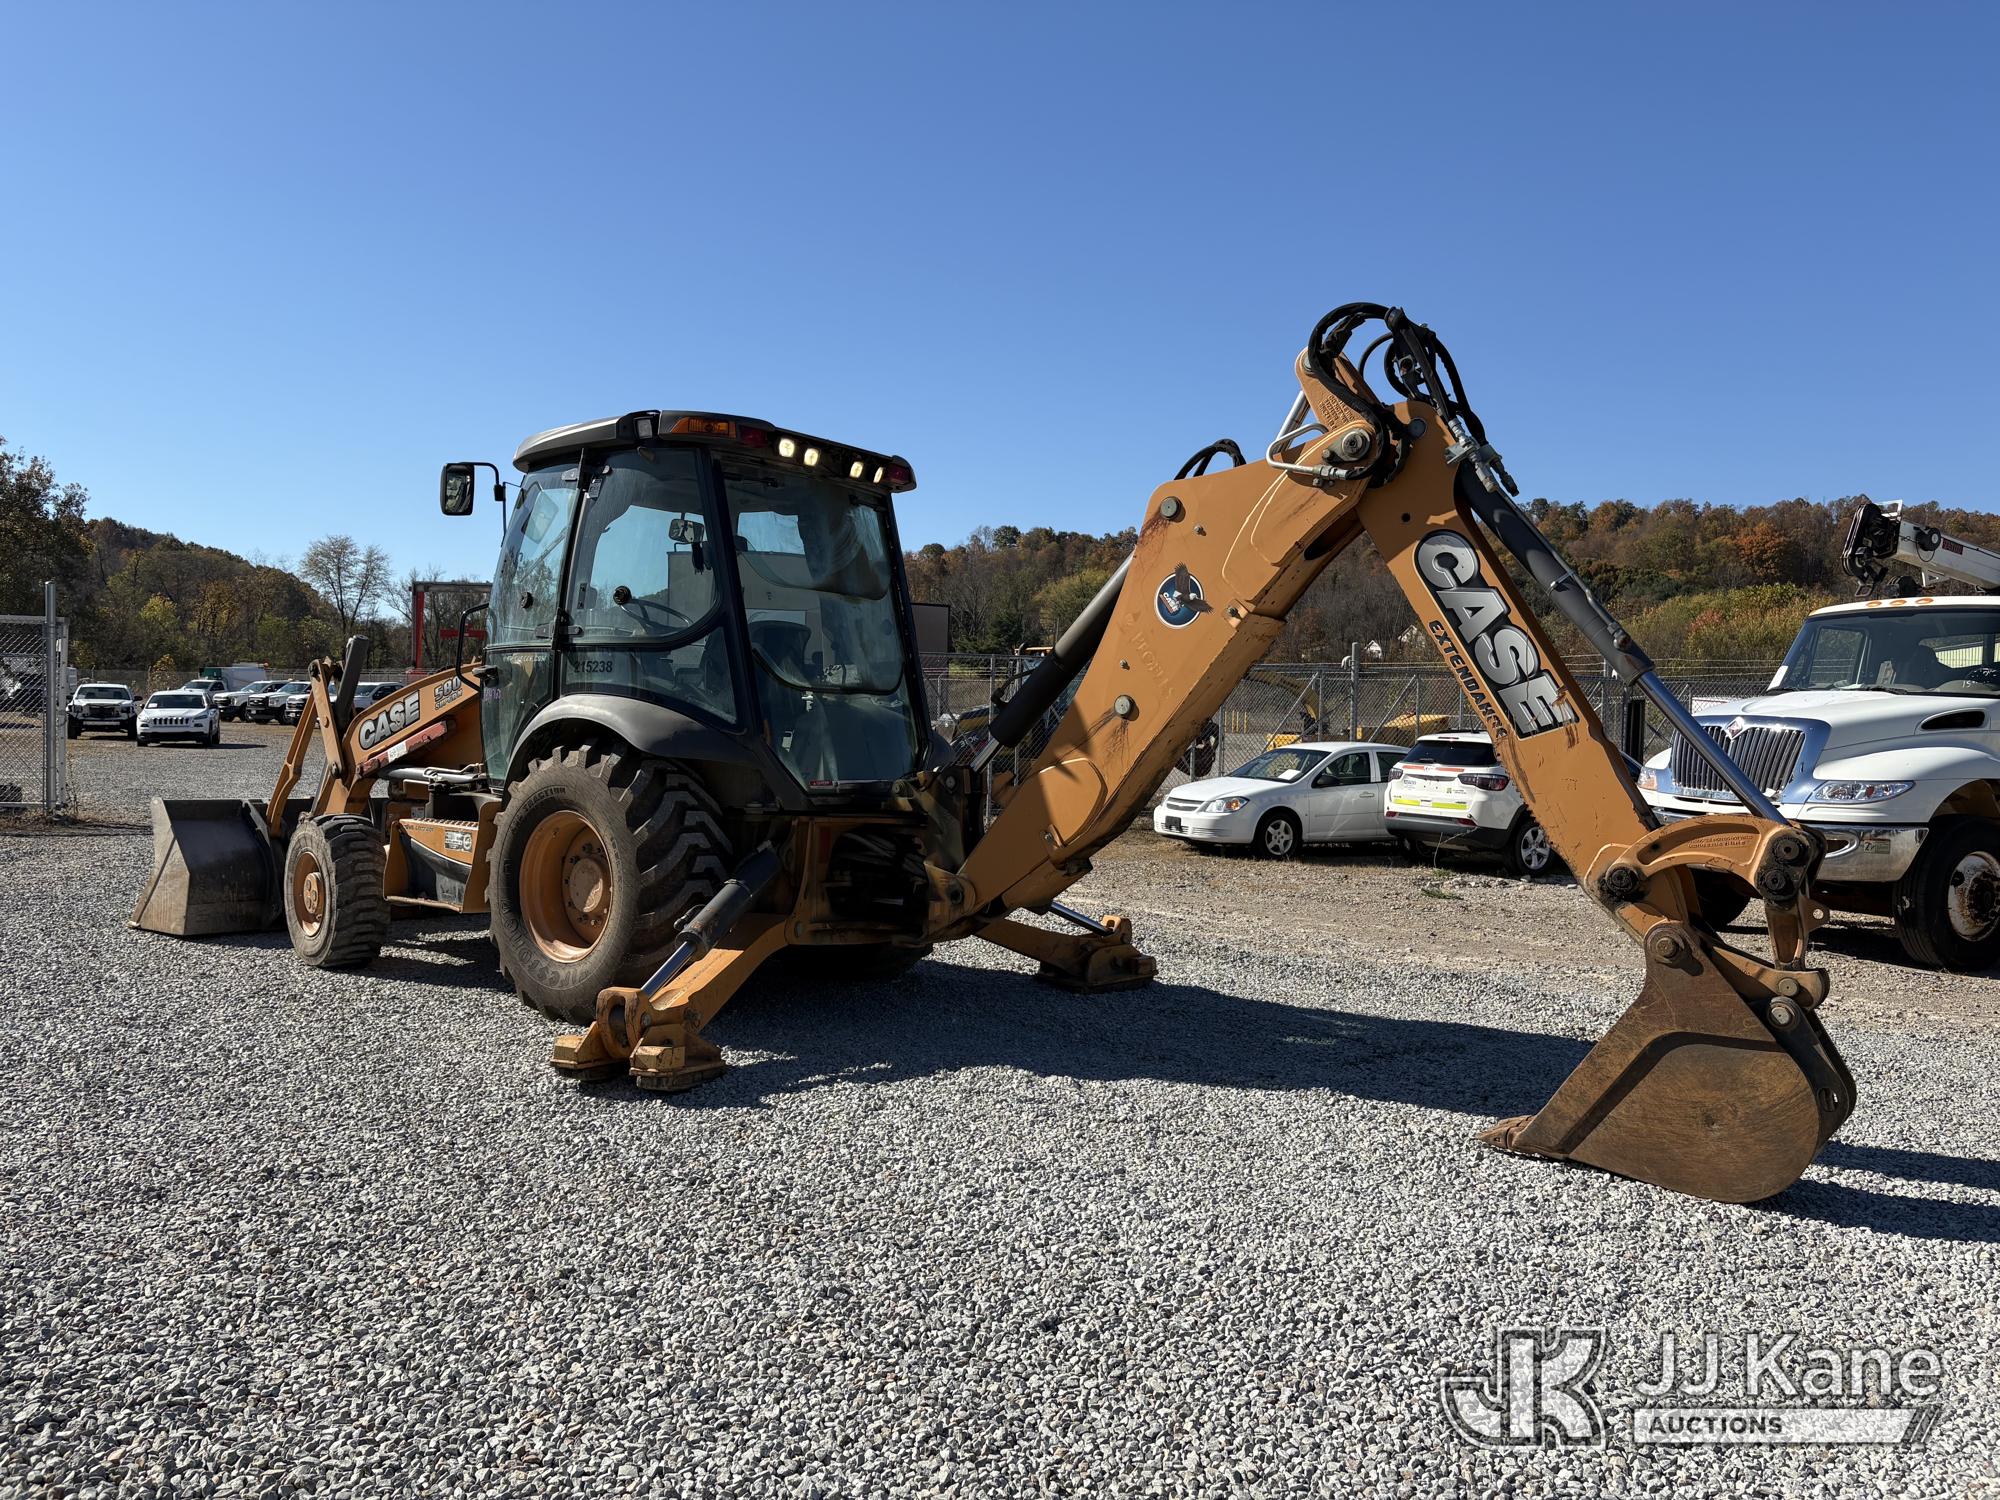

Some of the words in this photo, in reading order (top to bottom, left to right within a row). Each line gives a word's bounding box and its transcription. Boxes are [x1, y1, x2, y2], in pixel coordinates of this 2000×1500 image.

[1415, 530, 1579, 738] CASE
[434, 675, 461, 701] 580
[573, 660, 613, 673] 215238
[359, 690, 420, 750] CASE
